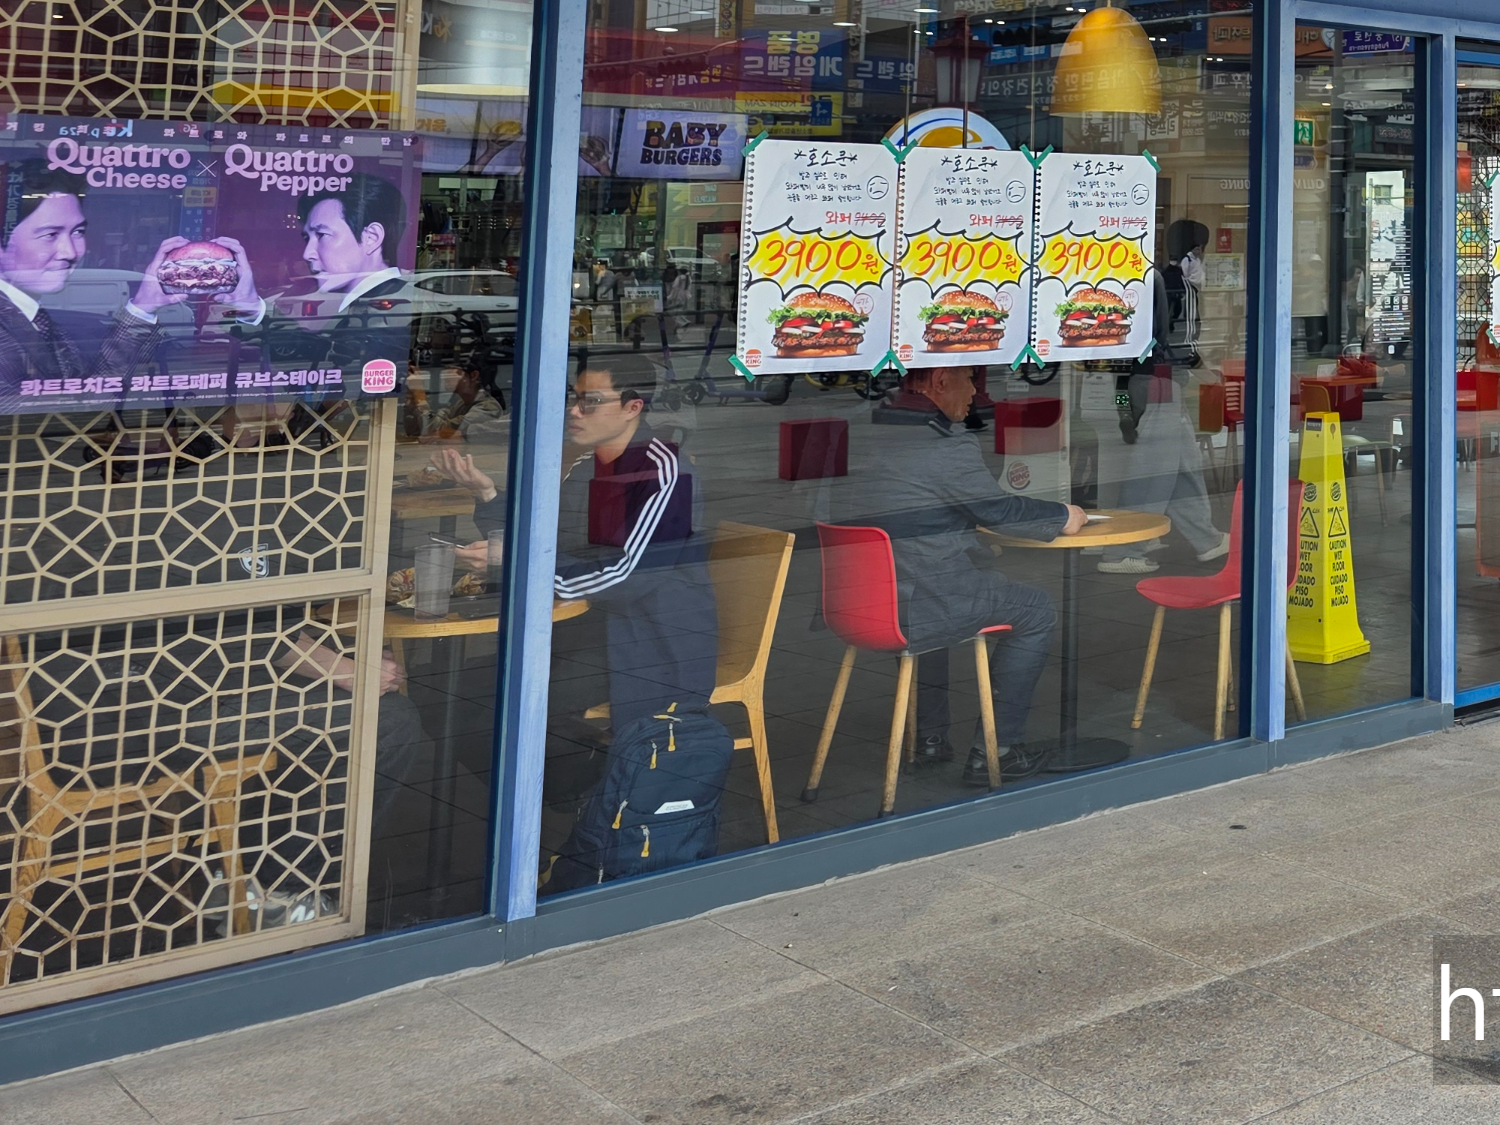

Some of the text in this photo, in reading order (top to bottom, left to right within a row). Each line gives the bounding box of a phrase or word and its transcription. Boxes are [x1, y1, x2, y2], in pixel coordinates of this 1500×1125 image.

[642, 121, 727, 149] BABY
[47, 137, 354, 178] Quattro Quattro
[640, 148, 722, 166] BURGERS
[86, 167, 352, 196] Cheese Pepper
[825, 211, 851, 225] 와퍼
[969, 214, 993, 226] 와퍼
[1099, 216, 1120, 228] 와퍼
[762, 239, 879, 278] 3900원
[914, 241, 1018, 277] 3900원
[1050, 241, 1143, 276] 3900원
[364, 369, 394, 378] BURGER
[19, 368, 343, 397] 콰트로치즈 콰트로페퍼 큐브스테이크
[362, 376, 394, 387] KING
[1299, 541, 1319, 551] UTION
[1329, 539, 1347, 550] CAUTION
[1334, 551, 1343, 562] WET
[1299, 562, 1313, 573] OOR
[1332, 562, 1345, 573] FLOOR
[1330, 574, 1348, 586] CUIDADO
[1295, 586, 1309, 596] PISO
[1334, 586, 1345, 596] PISO
[1288, 597, 1314, 608] MOJADO
[1331, 598, 1349, 608] MOJADO
